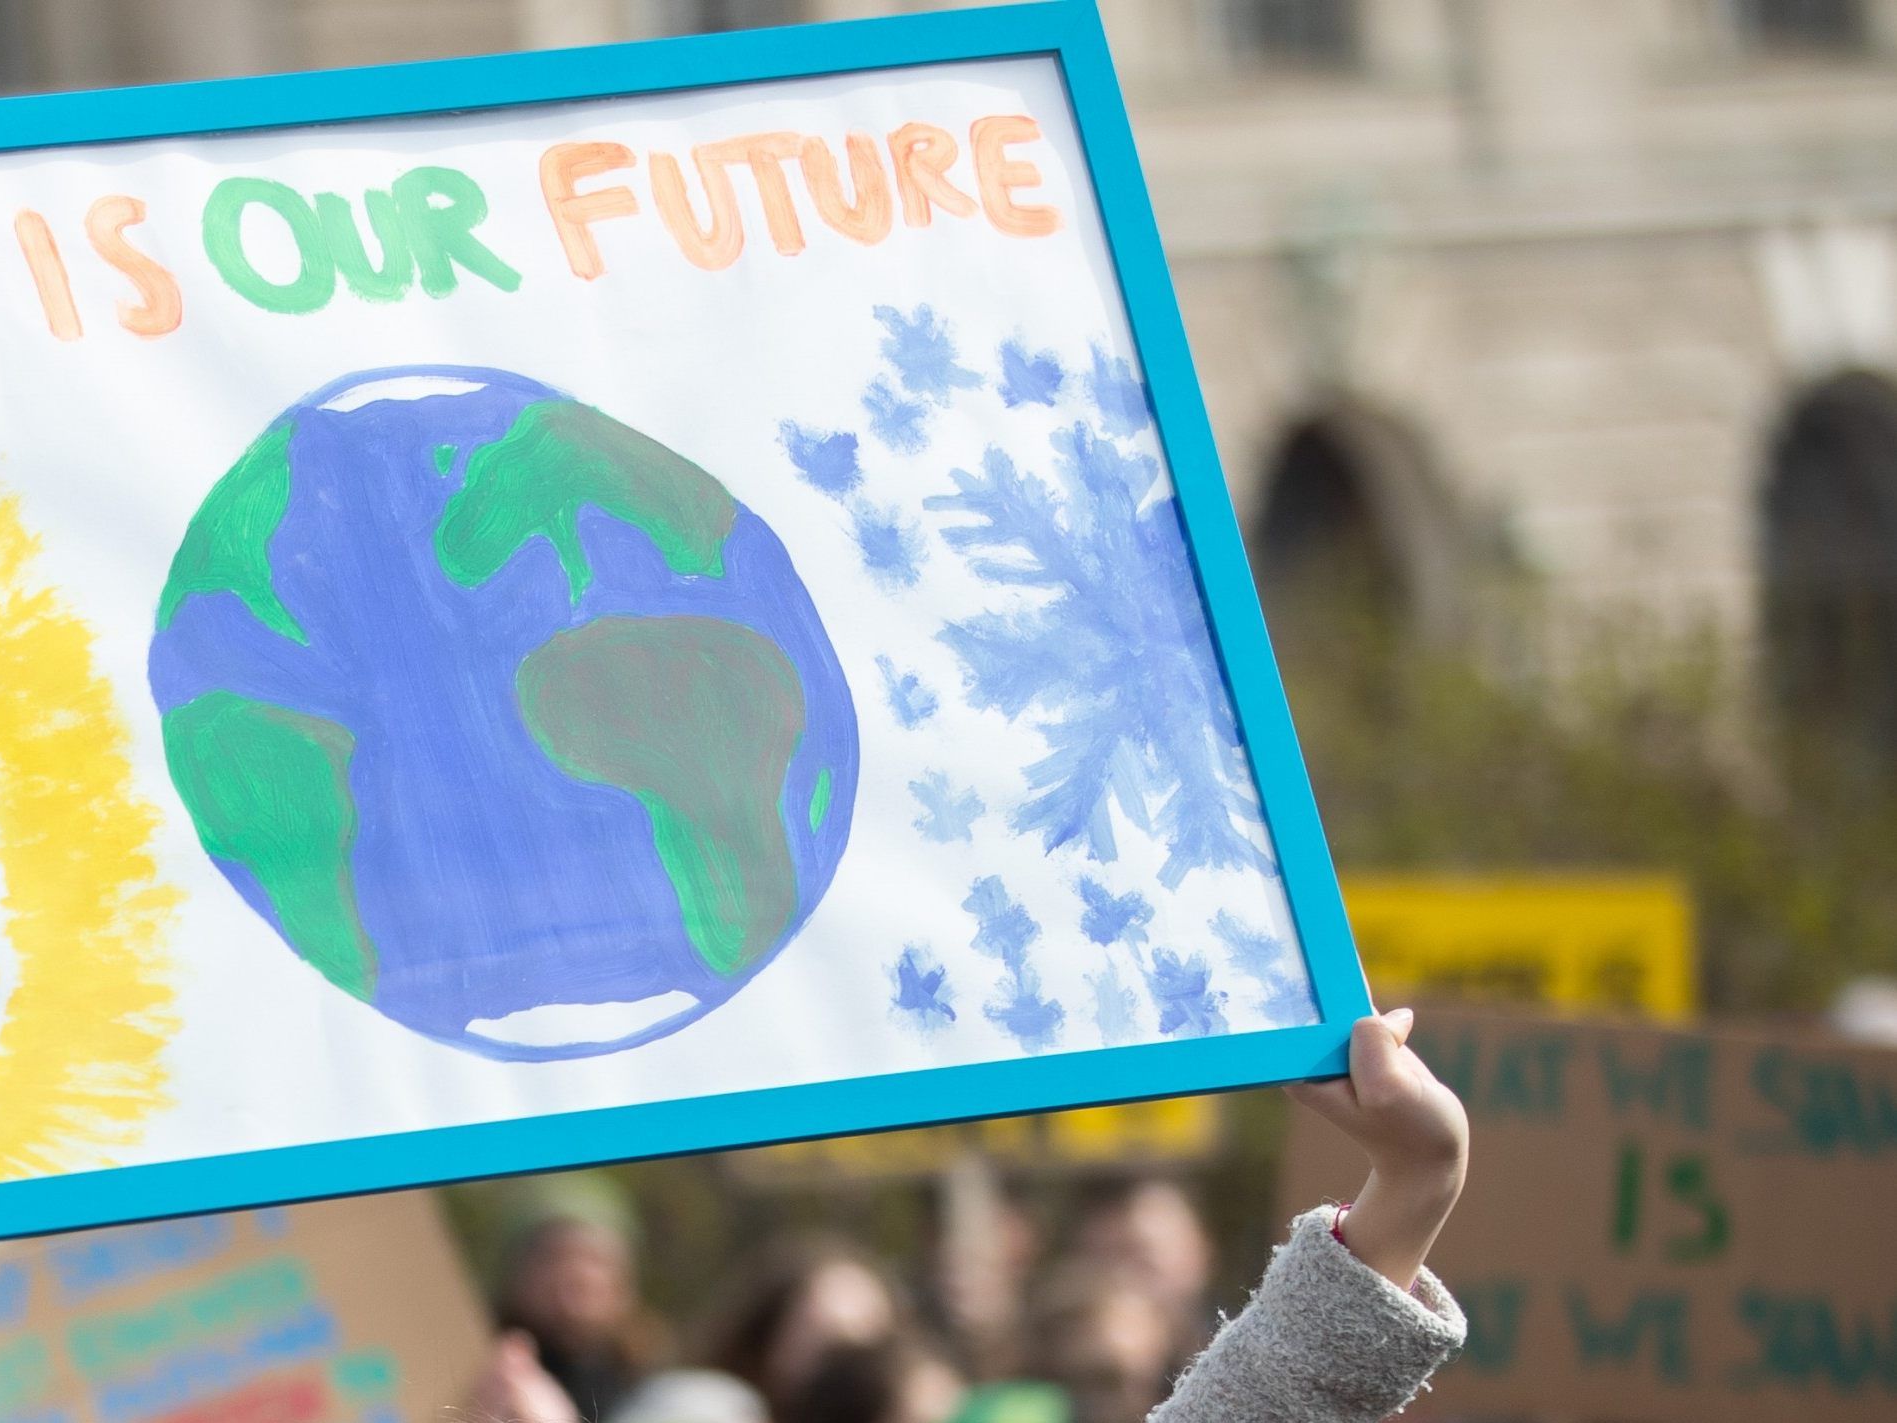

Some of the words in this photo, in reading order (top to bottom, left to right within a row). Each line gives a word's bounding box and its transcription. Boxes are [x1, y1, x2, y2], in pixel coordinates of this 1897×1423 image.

[16, 197, 183, 340] IS
[202, 166, 523, 316] OUR
[540, 114, 1060, 281] FUTURE
[1610, 1138, 1731, 1262] IS
